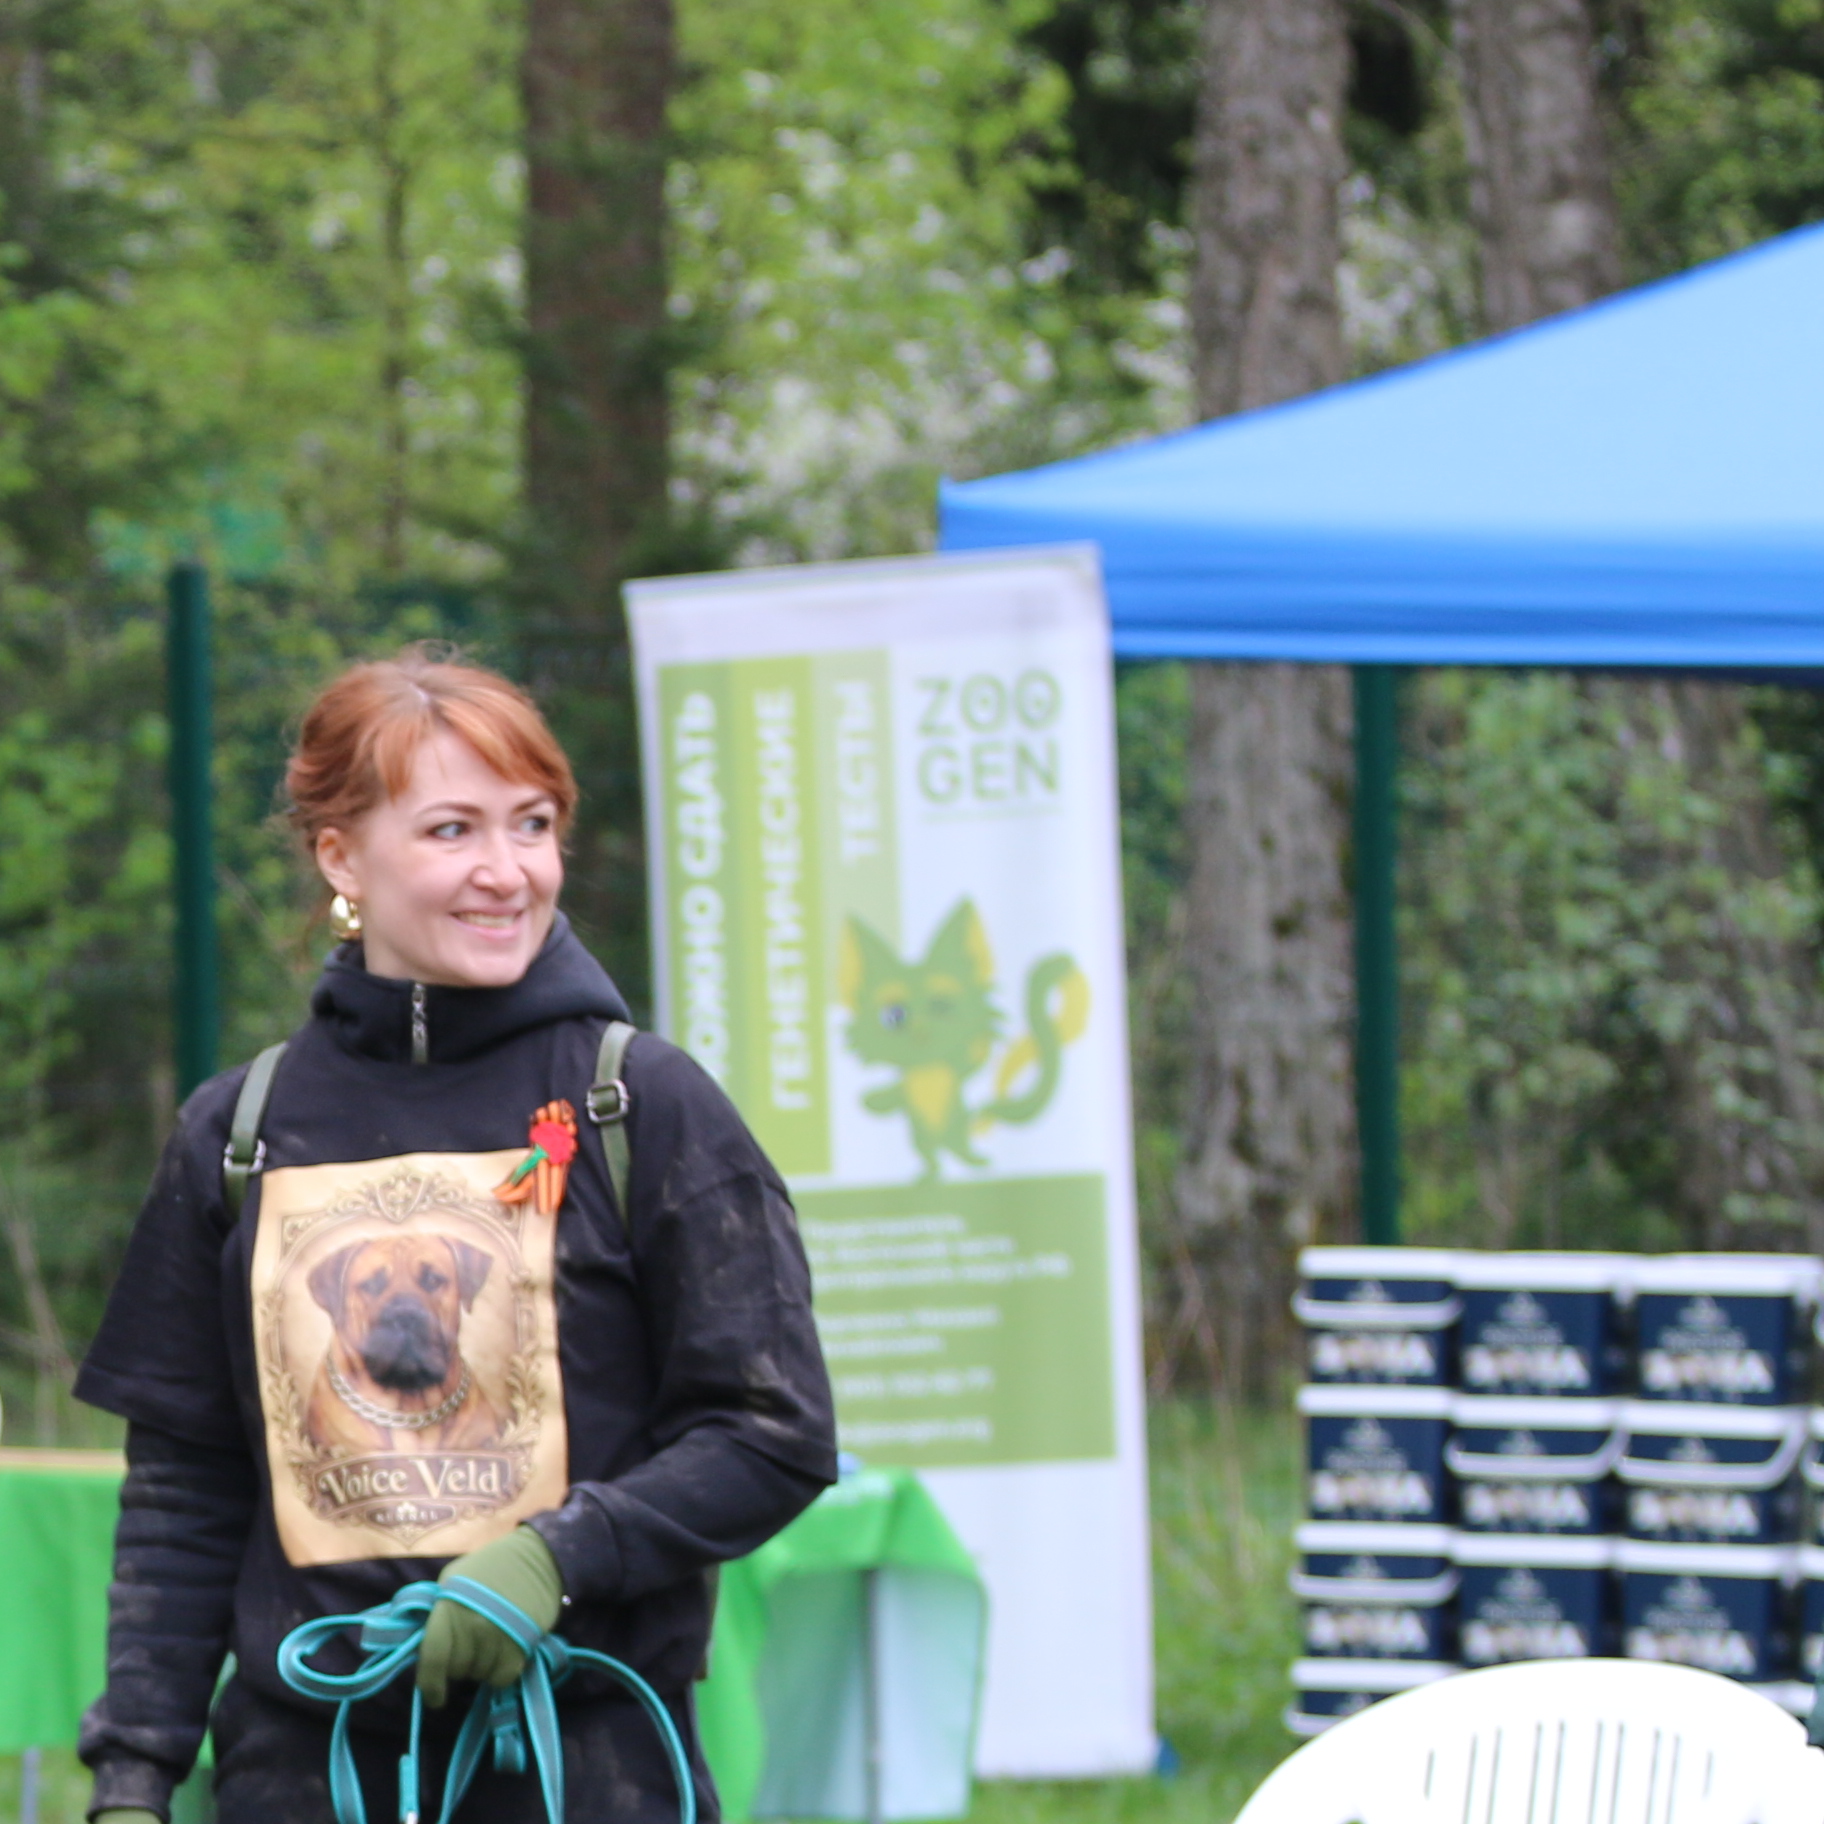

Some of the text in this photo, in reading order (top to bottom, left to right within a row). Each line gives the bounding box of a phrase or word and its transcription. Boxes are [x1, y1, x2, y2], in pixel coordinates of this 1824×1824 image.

[916, 669, 1061, 737] ZOO
[837, 680, 882, 862] ТЕСТЫ
[918, 740, 1058, 805] GEN
[674, 692, 731, 1082] ОЖНО СДАТЬ
[756, 688, 809, 1108] ГЕНЕТИЧЕСКИЕ
[319, 1458, 499, 1504] Voice Veld
